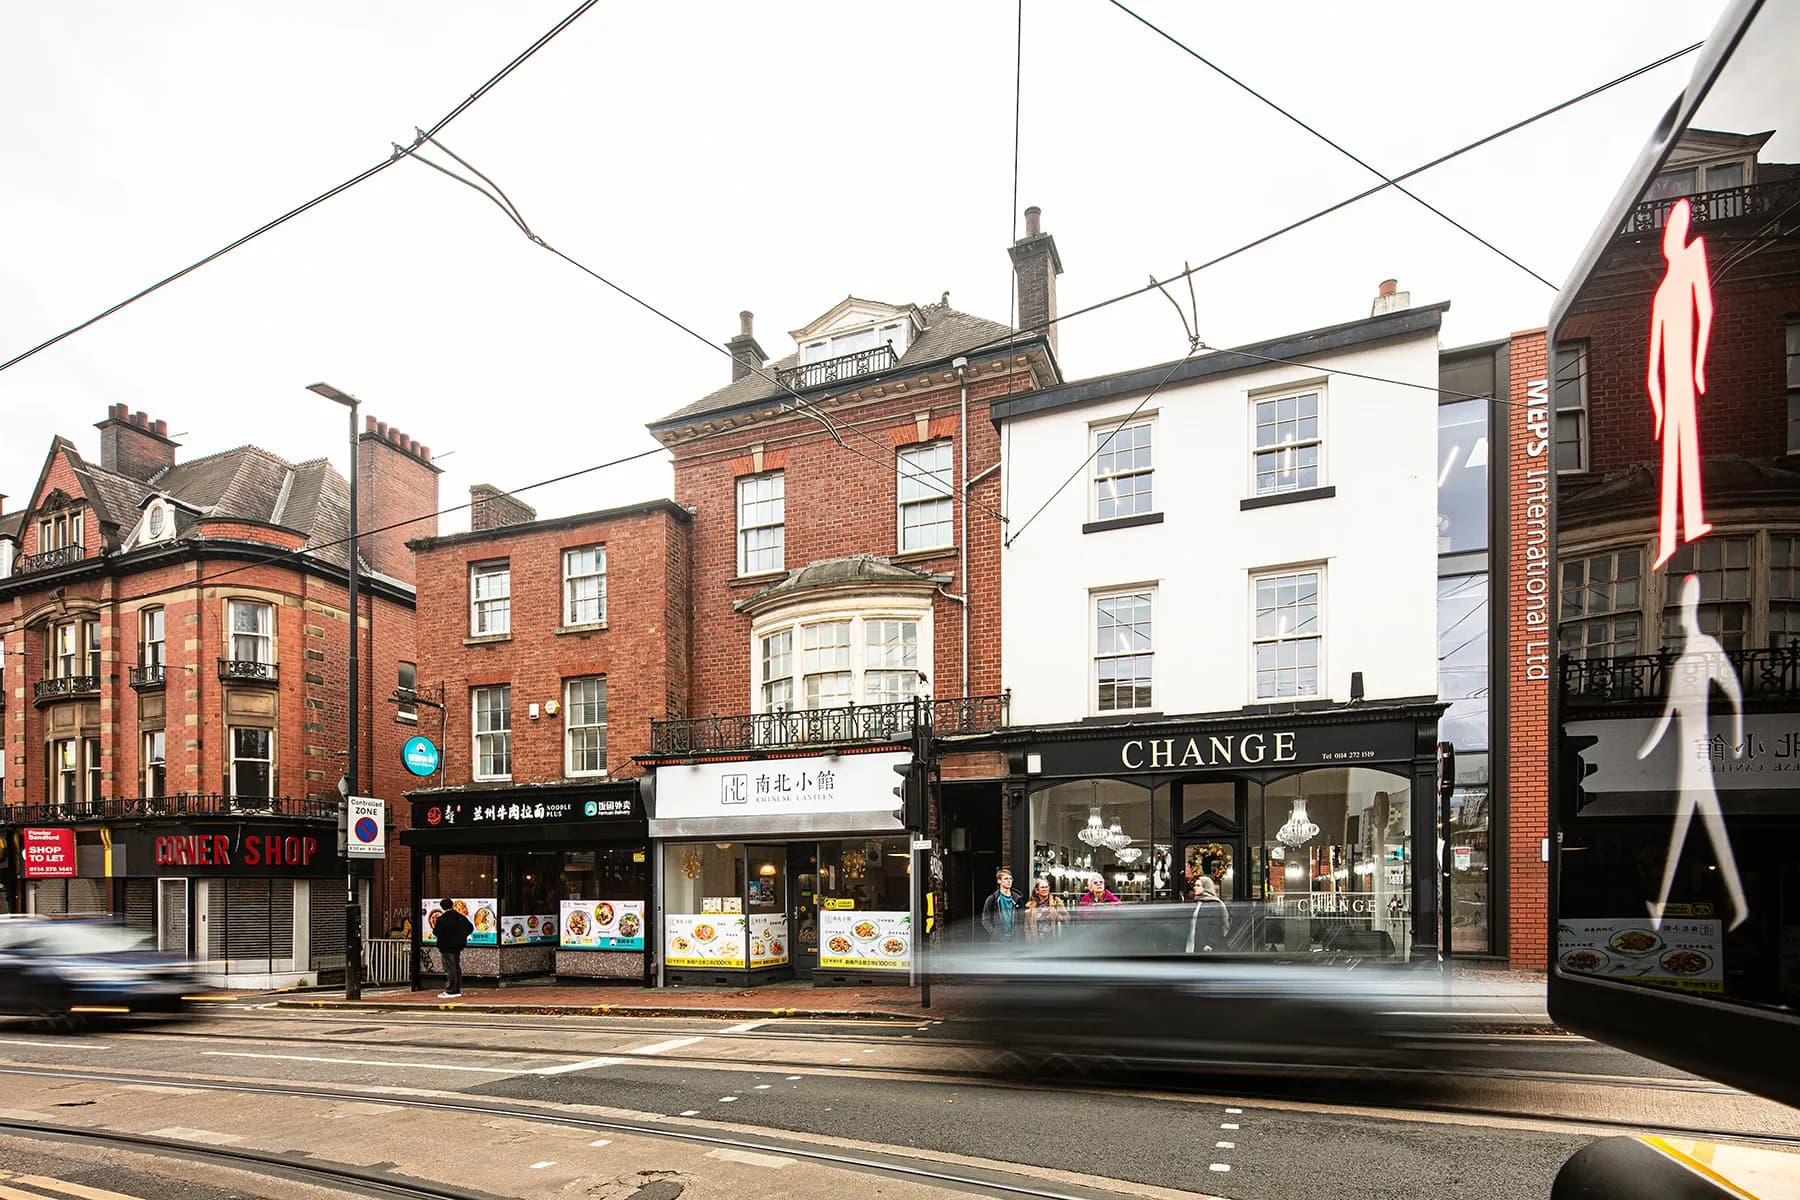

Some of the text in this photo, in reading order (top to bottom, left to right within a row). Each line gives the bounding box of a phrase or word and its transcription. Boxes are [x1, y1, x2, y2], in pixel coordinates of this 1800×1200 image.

[1526, 379, 1549, 680] MEPS International Ltd
[1121, 731, 1297, 769] CHANGE
[1334, 752, 1348, 760] 0114
[756, 770, 836, 794] 南北小館
[351, 799, 383, 807] Controlled
[546, 803, 572, 811] NOODLE
[355, 807, 378, 816] ZONE
[472, 802, 545, 821] 兰州牛肉拉面
[29, 846, 62, 854] SHOP
[155, 834, 318, 865] CORNER SHOP
[29, 854, 65, 862] TO LET
